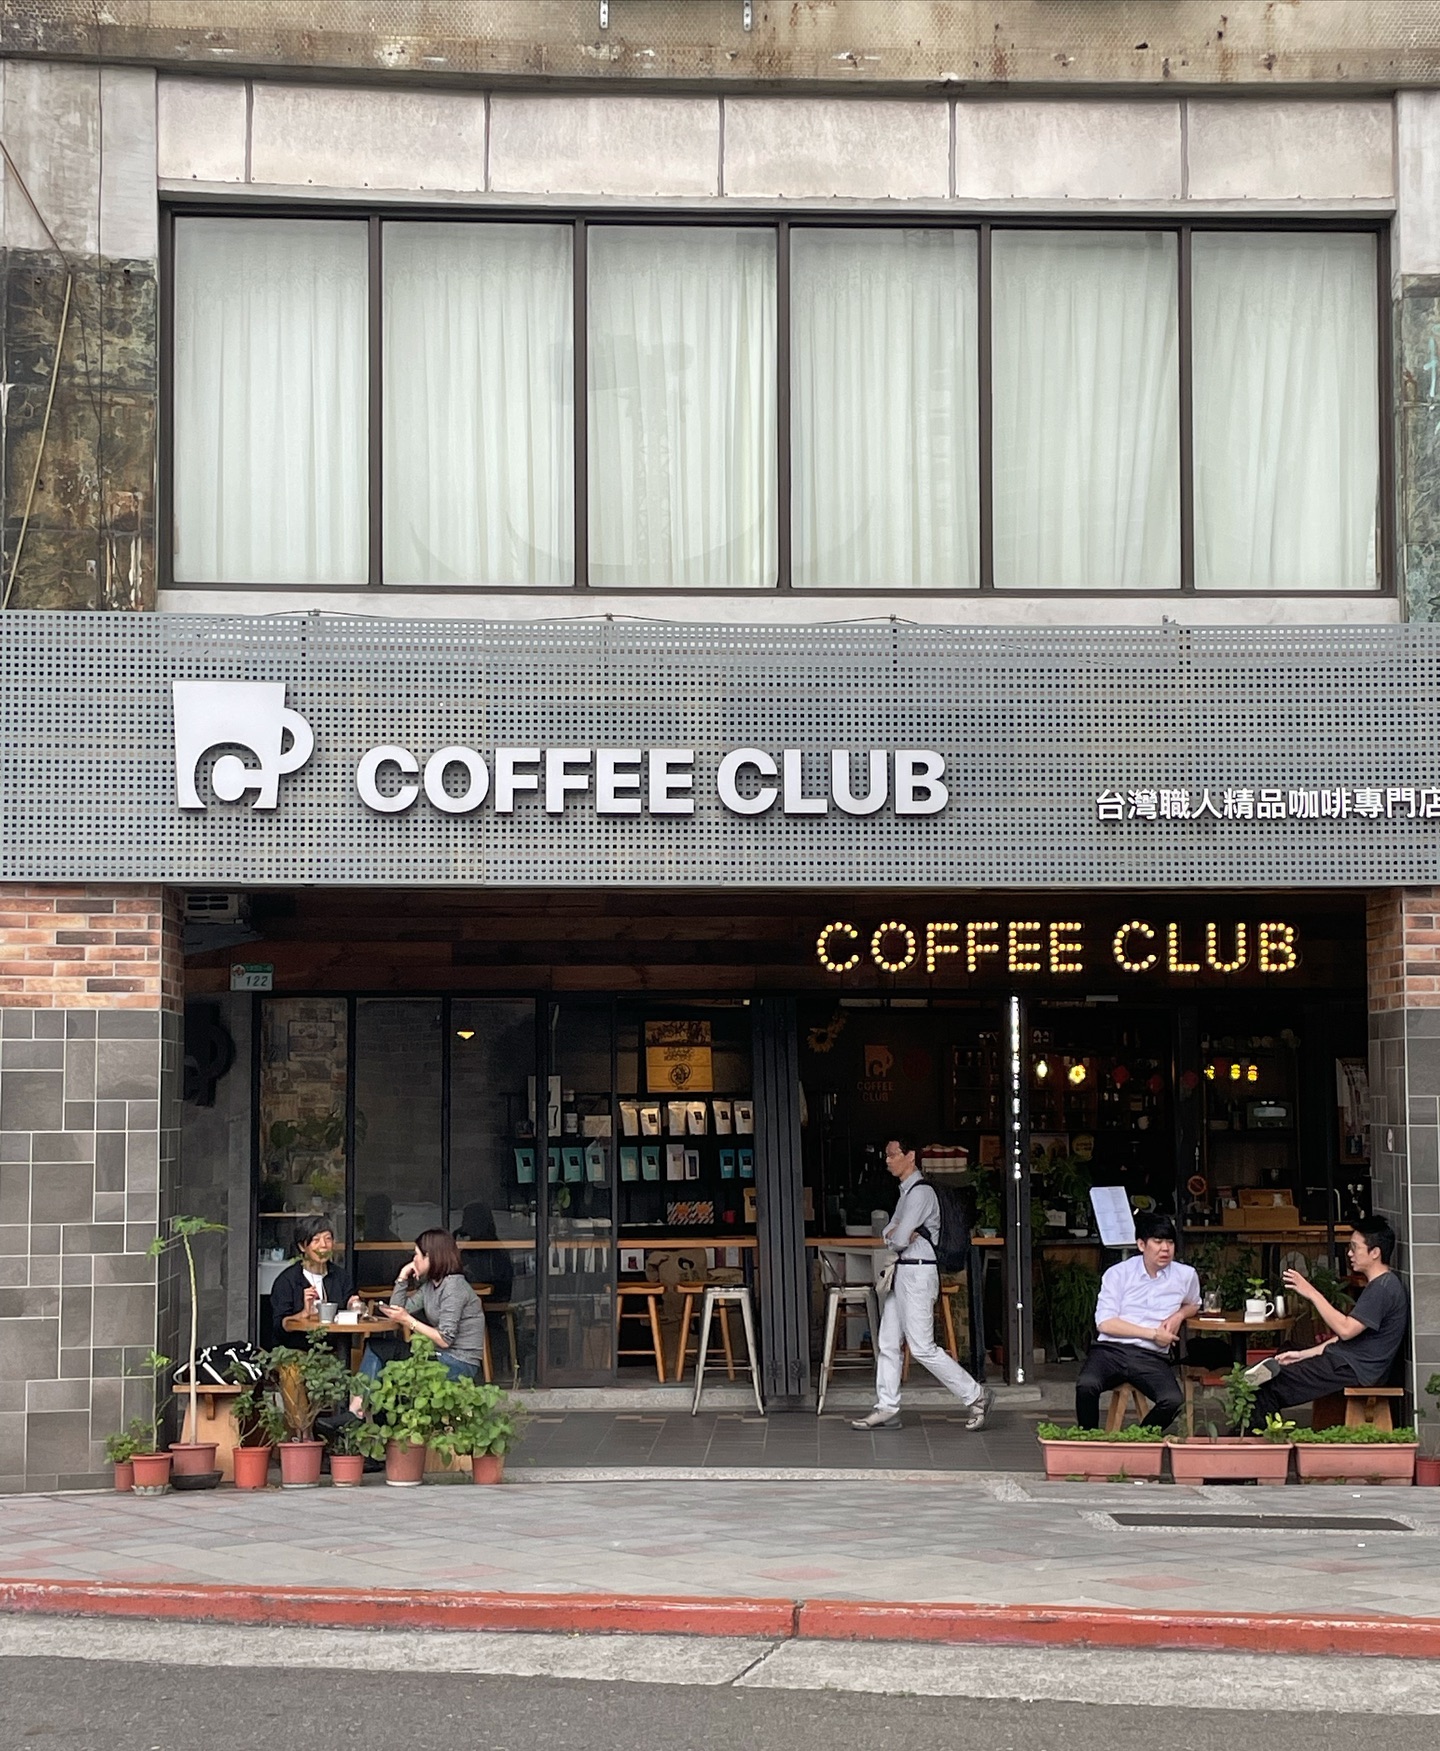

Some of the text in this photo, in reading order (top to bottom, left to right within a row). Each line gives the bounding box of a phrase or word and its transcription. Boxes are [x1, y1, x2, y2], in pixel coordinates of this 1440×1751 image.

[356, 744, 949, 817] COFFEE CLUB
[1095, 786, 1440, 820] 台灣職人精品咖啡專門店
[816, 920, 1299, 972] COFFEE CLUB
[246, 975, 268, 987] 122
[856, 1081, 895, 1091] COFFEE
